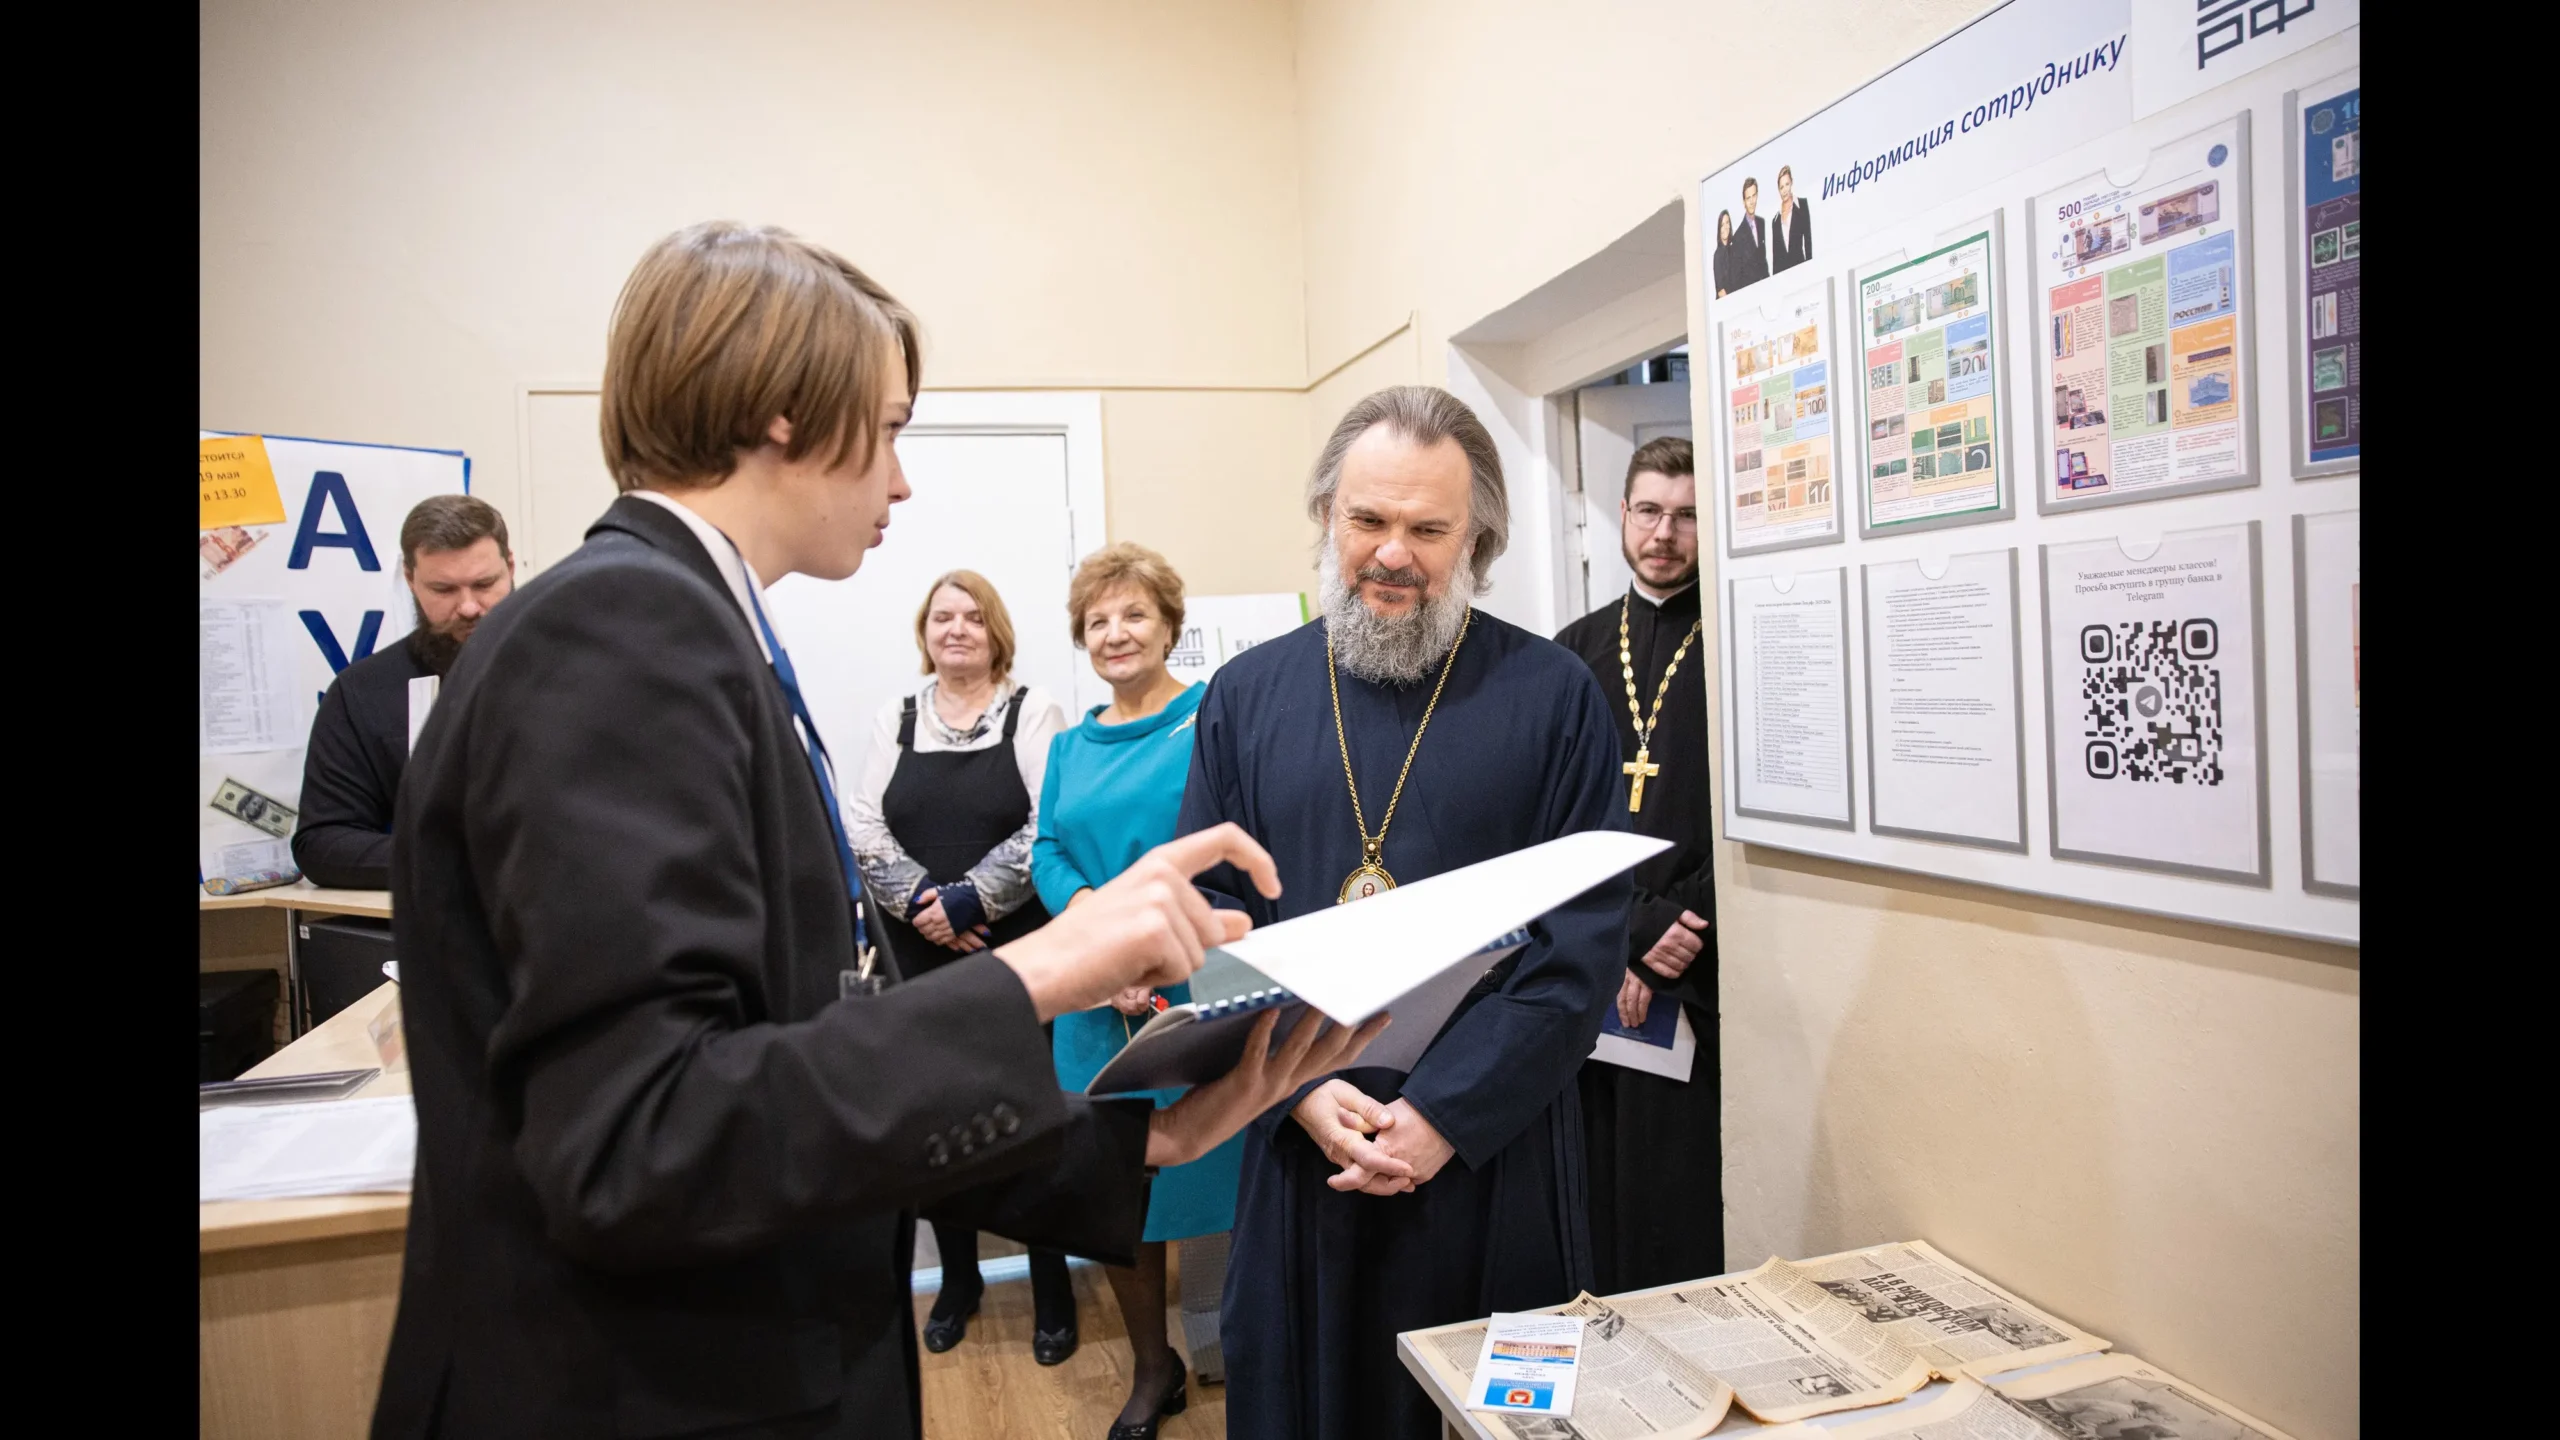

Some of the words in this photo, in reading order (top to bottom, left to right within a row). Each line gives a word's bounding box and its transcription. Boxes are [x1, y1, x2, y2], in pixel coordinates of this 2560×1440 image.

[1822, 119, 1954, 201] Информация
[1961, 33, 2127, 133] сотруднику
[2058, 200, 2081, 221] 500
[1866, 281, 1880, 295] 200
[217, 471, 240, 481] мая
[204, 493, 211, 502] в
[214, 487, 247, 501] 13.30
[2078, 568, 2124, 580] Уважаемые
[2126, 563, 2176, 577] менеджеры
[2178, 558, 2217, 571] классов!
[2075, 581, 2108, 594] Просьба
[2110, 578, 2147, 592] вступить
[2155, 576, 2185, 588] группу
[2188, 573, 2214, 584] банка
[2217, 573, 2223, 581] в
[2126, 591, 2165, 603] Telegram
[1860, 1277, 1895, 1294] ДЕЛЕ
[1877, 1272, 1897, 1280] Я
[1888, 1278, 1906, 1286] В
[1898, 1284, 1986, 1332] БАНКОВСКОМ
[1742, 1296, 1770, 1319] играют
[1773, 1323, 1812, 1355] банкиров
